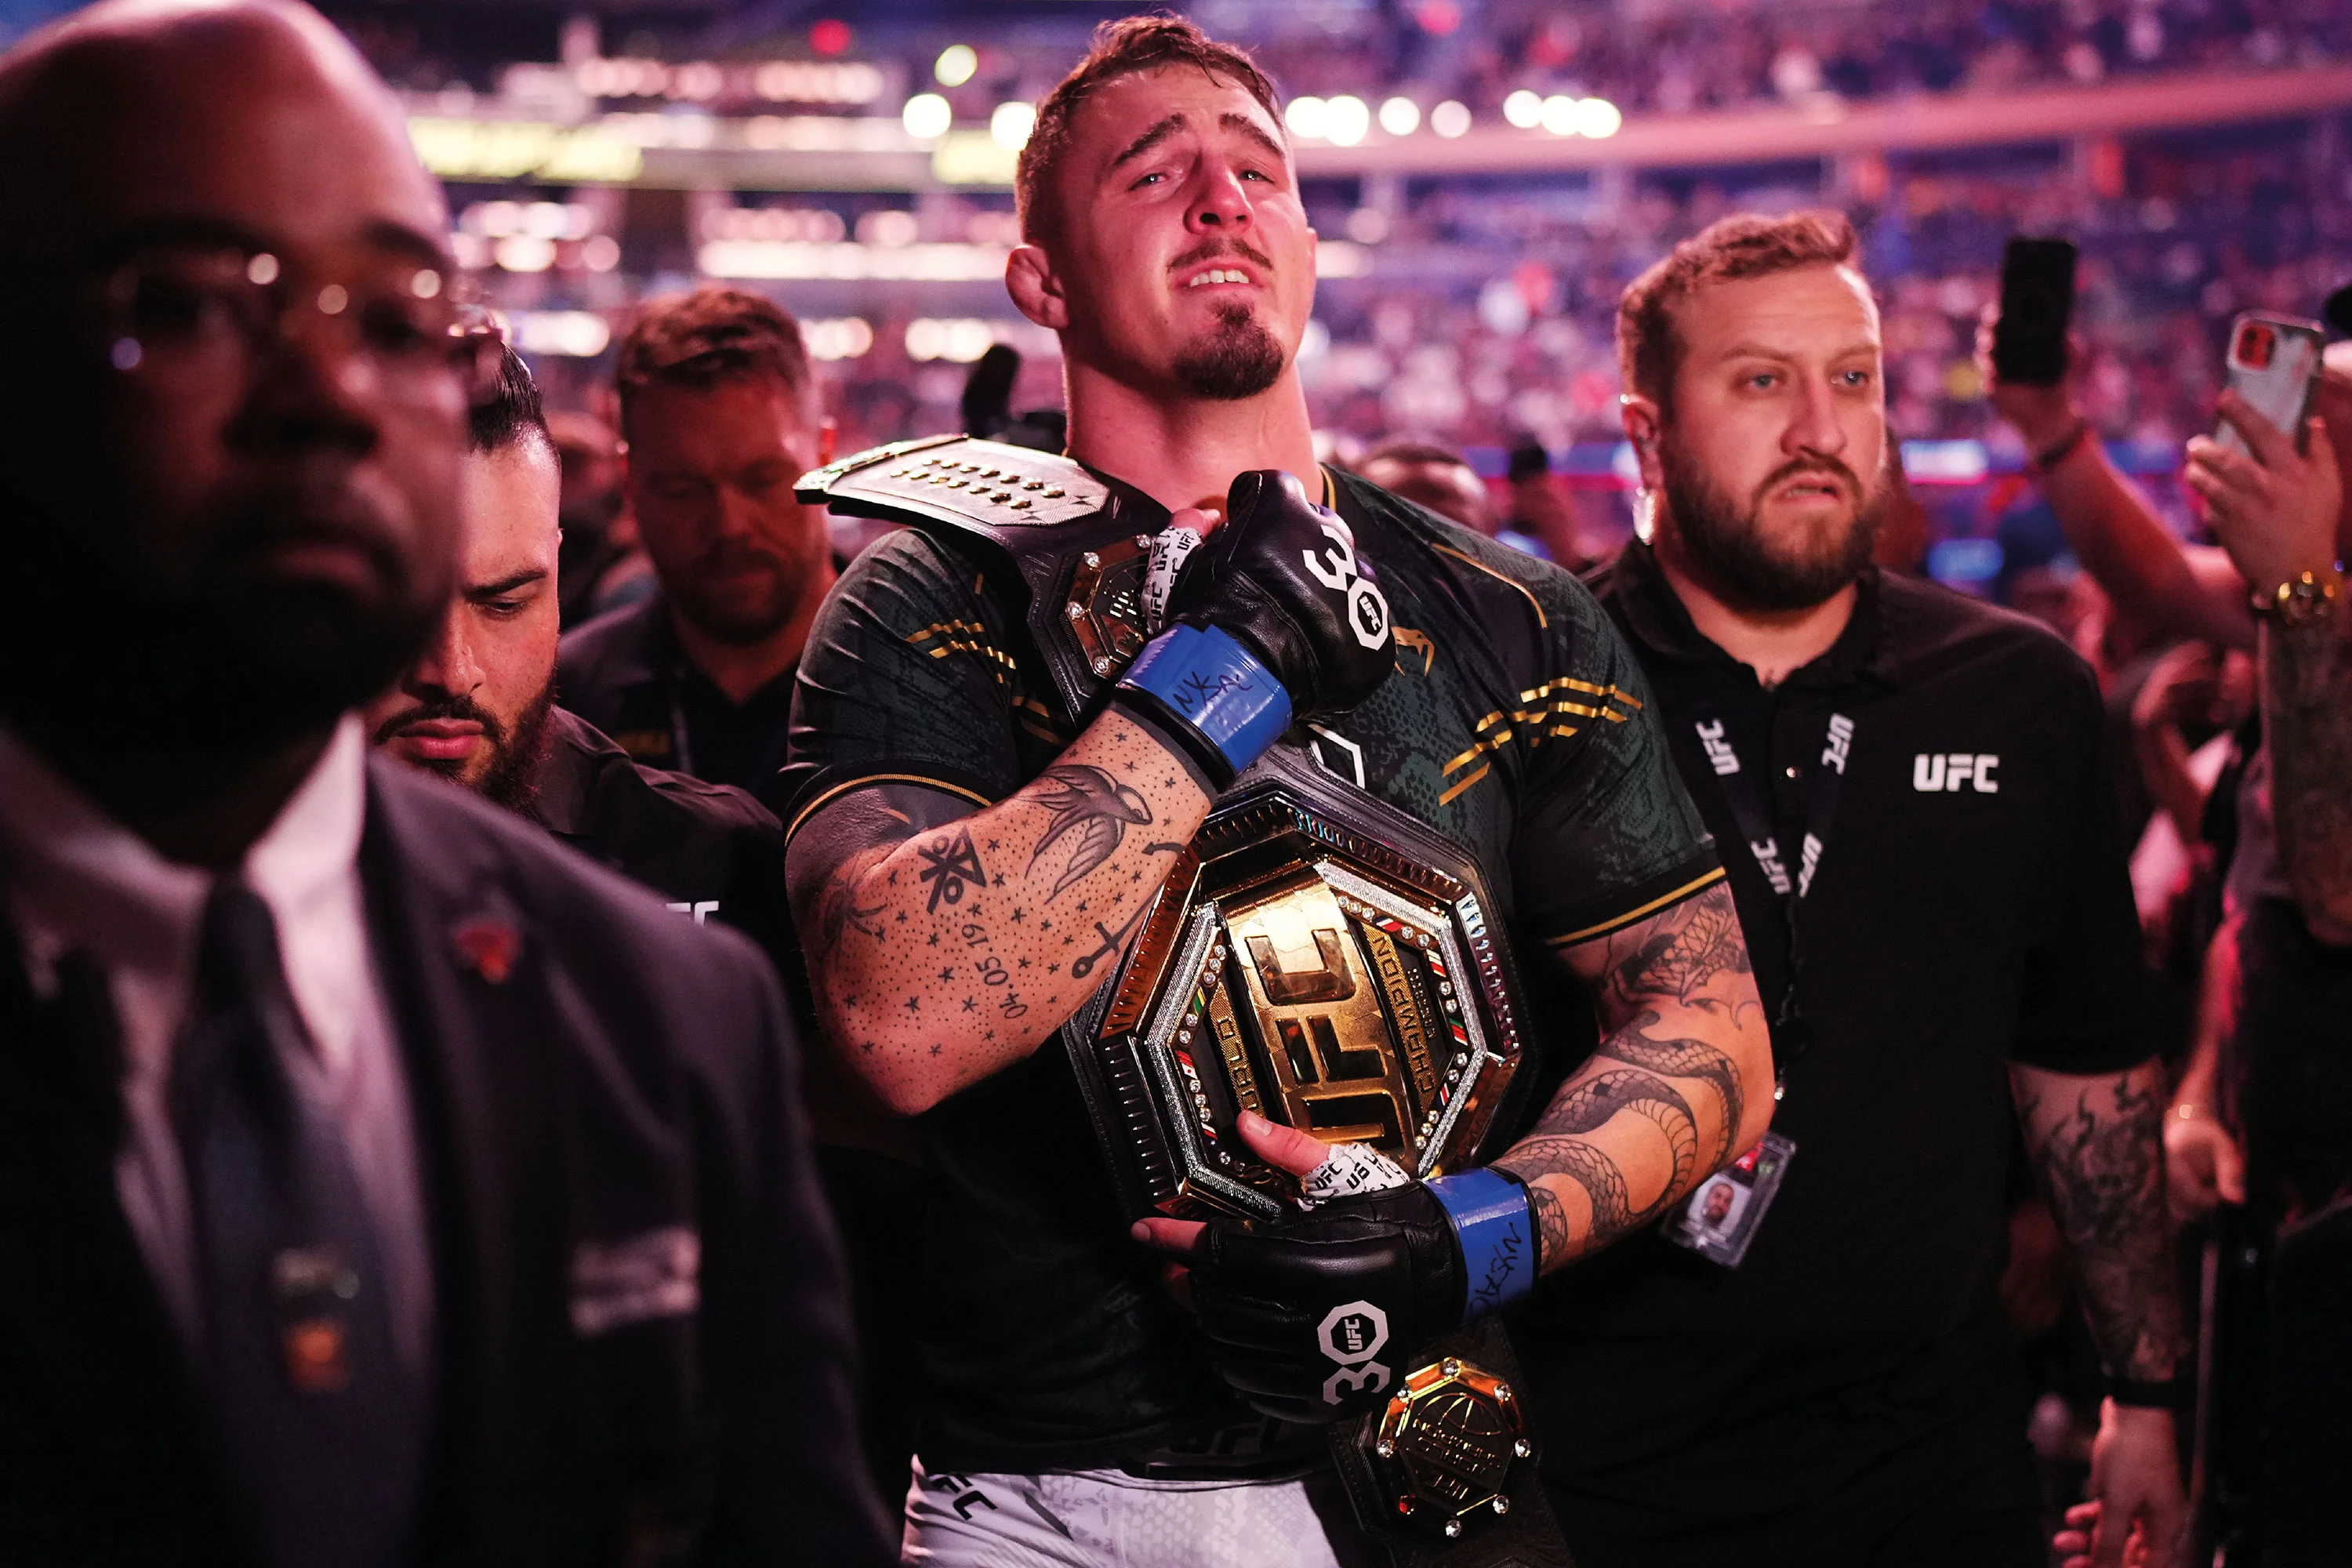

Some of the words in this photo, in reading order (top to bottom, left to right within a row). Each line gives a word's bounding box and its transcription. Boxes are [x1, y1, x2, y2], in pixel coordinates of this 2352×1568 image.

[1359, 595, 1382, 631] UFC
[1695, 718, 1740, 775] UFC
[1821, 713, 1856, 775] UFC
[1912, 753, 2000, 793] UFC
[1750, 837, 1792, 895] UFC
[1374, 937, 1436, 1092] CHAMPION
[1216, 1016, 1259, 1109] ORLD
[1314, 1161, 1343, 1190] UFC
[1344, 1317, 1363, 1351] UFC
[930, 1474, 997, 1521] FC
